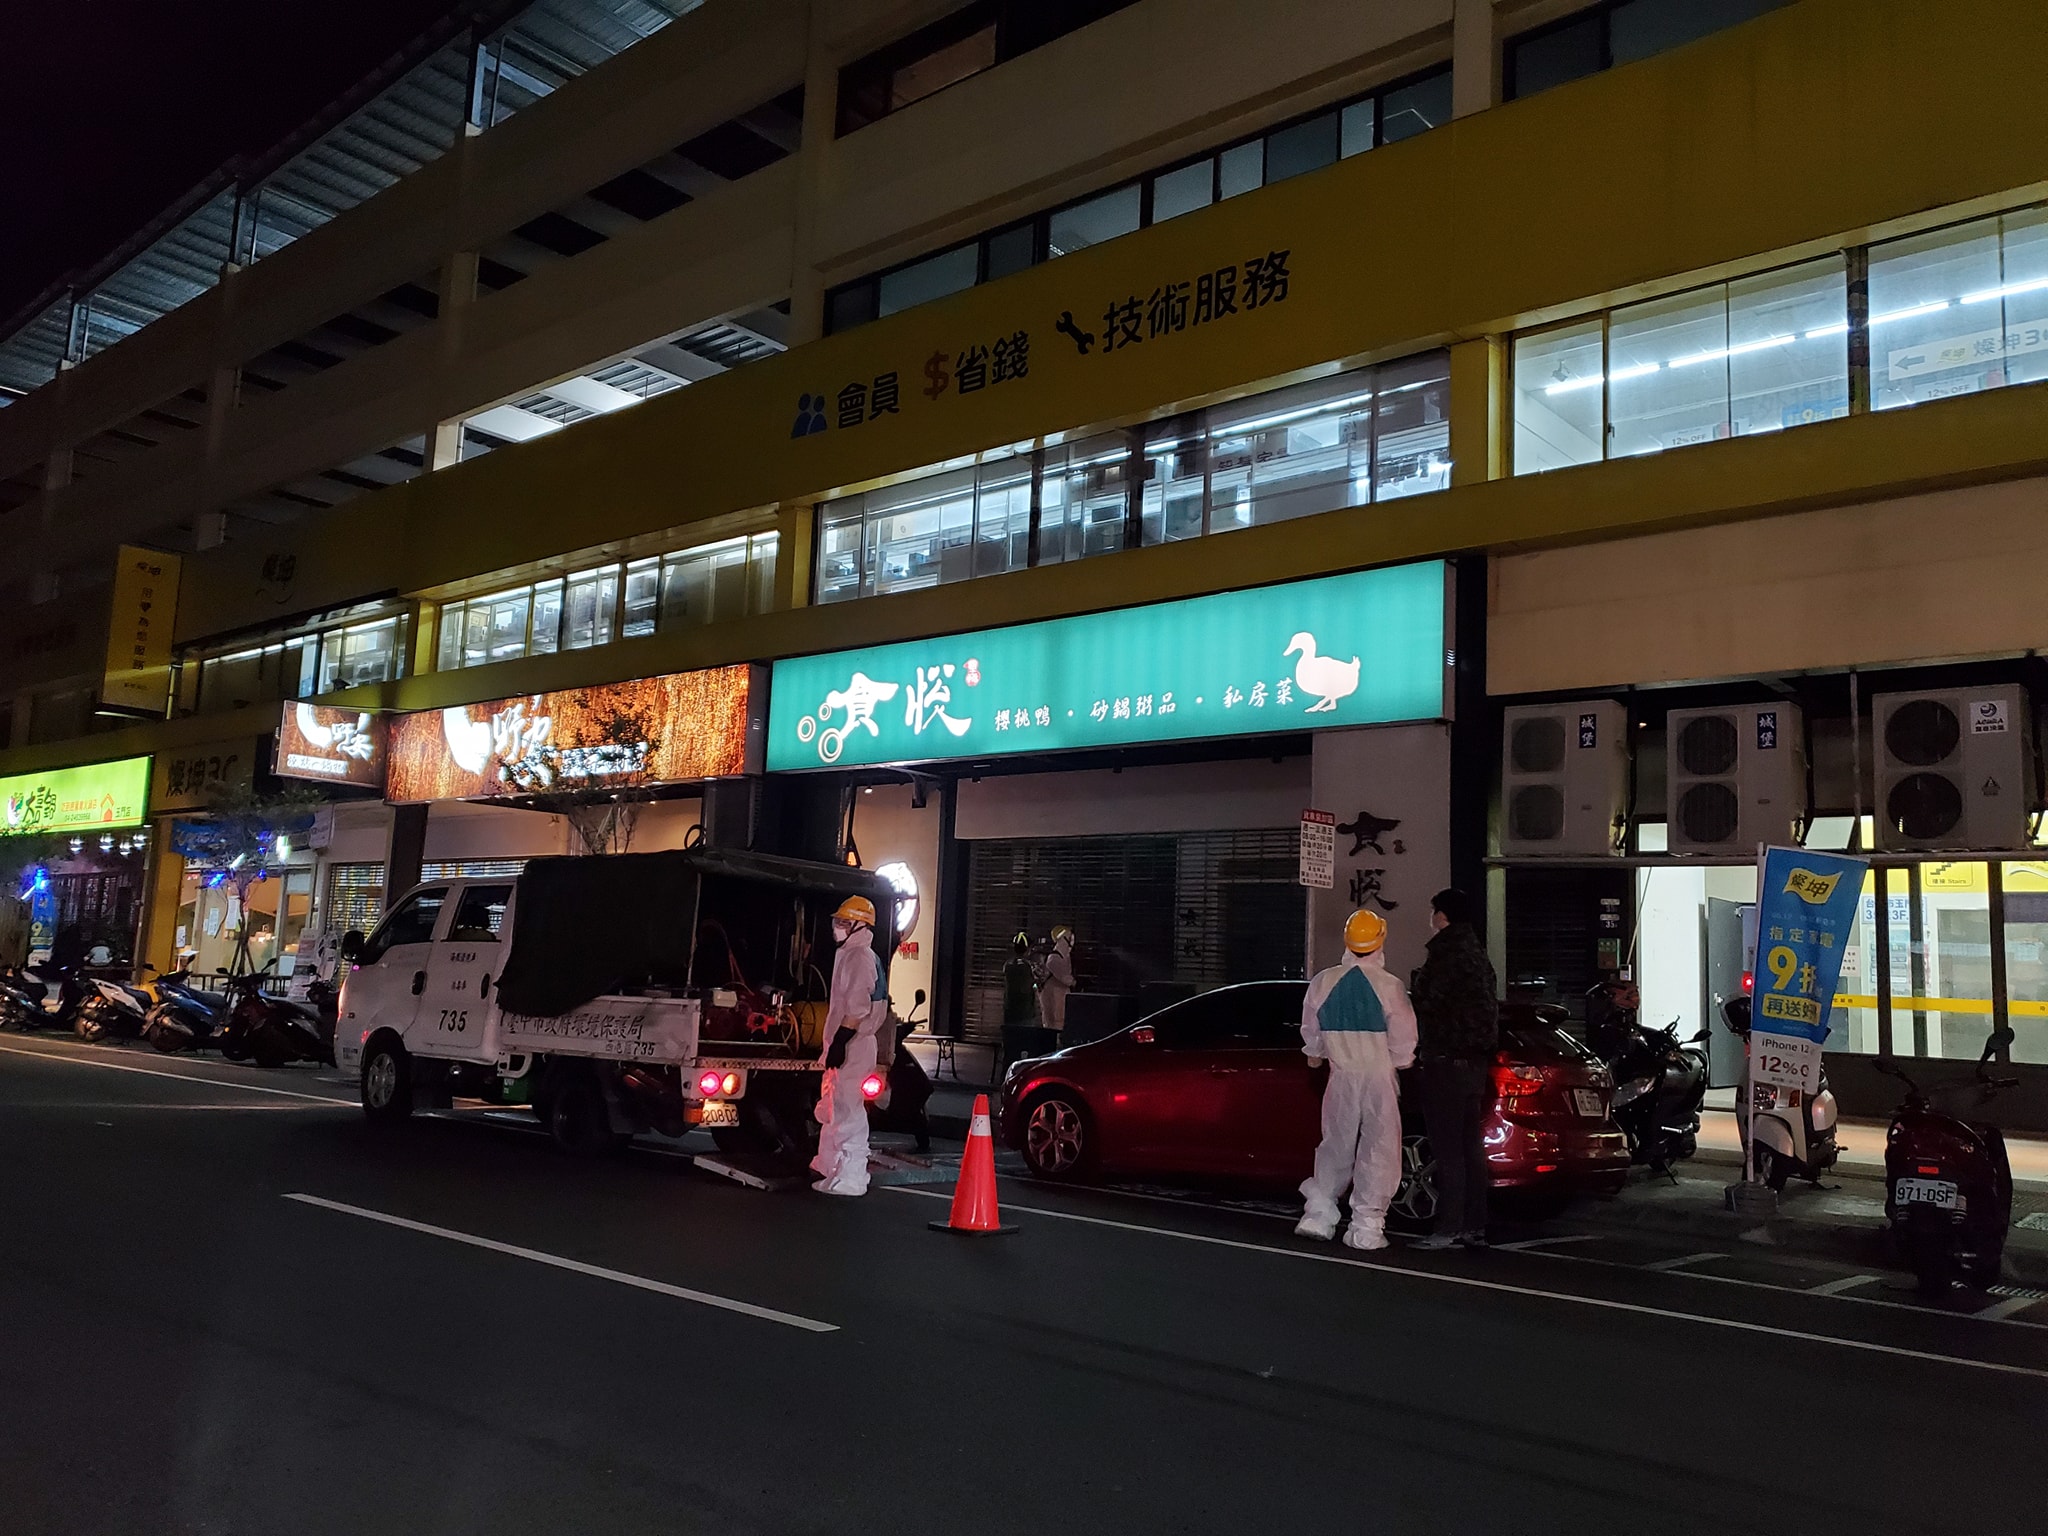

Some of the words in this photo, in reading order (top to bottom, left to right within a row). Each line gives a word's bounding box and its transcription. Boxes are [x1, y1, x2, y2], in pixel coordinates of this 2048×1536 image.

[838, 372, 899, 429] 會員
[1102, 250, 1290, 353] 技術服務
[994, 705, 1051, 731] 櫻桃鴨
[1090, 692, 1176, 722] 砂鍋粥品
[1222, 677, 1294, 707] 私房菜
[1581, 717, 1595, 747] 城堡
[1759, 715, 1774, 747] 城堡
[1791, 873, 1829, 897] 燦坤
[439, 1010, 467, 1032] 735
[1762, 1038, 1797, 1051] iPhone
[1760, 1055, 1798, 1075] 12%
[1897, 1187, 1954, 1203] 971-DSF
